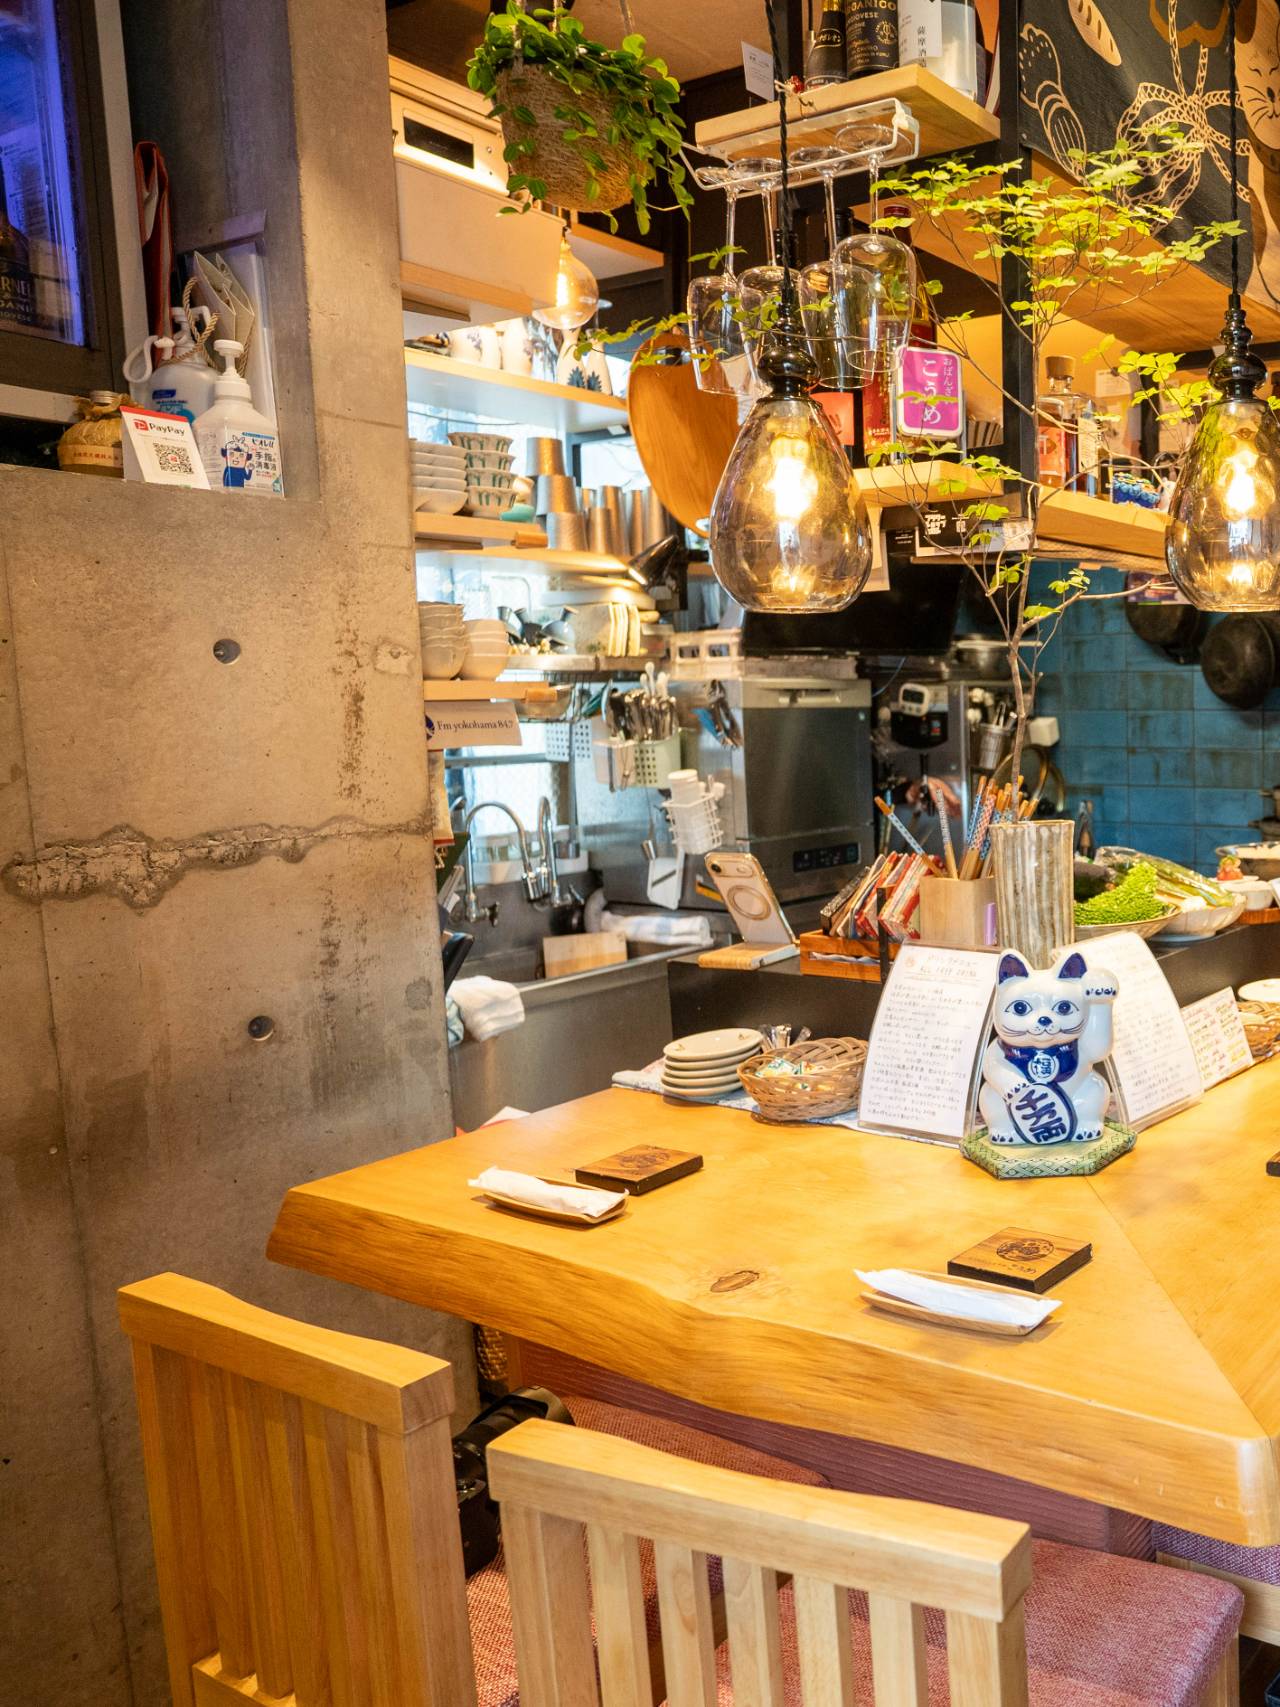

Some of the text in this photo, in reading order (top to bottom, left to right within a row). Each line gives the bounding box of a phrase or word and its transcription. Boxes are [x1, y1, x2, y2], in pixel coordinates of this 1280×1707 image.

[943, 358, 954, 405] おばんざ
[149, 422, 185, 437] PayPay
[453, 719, 497, 732] yokohama
